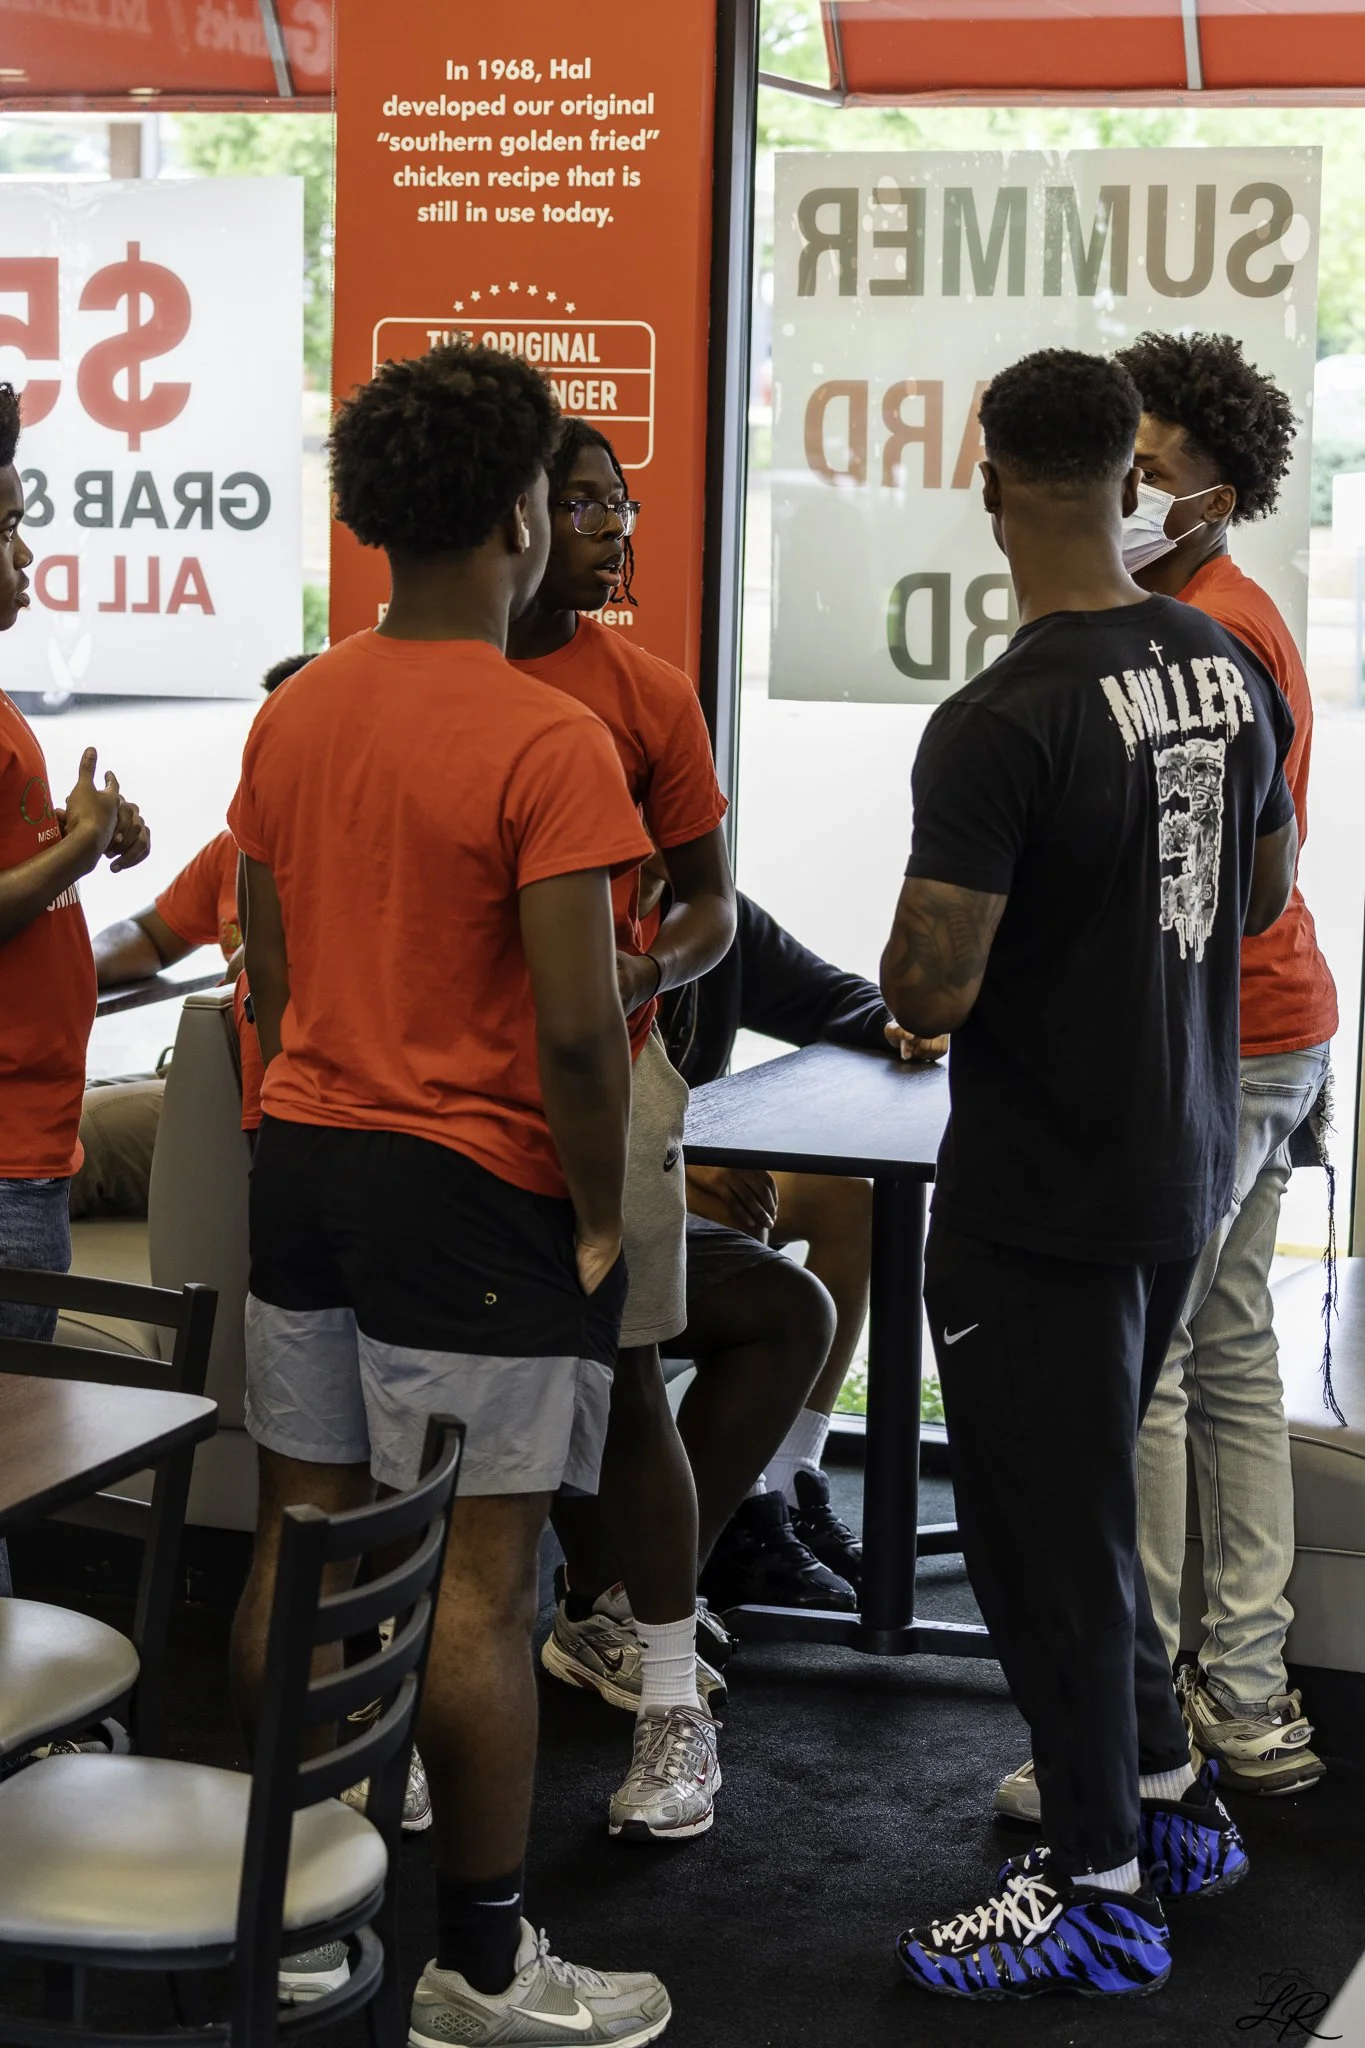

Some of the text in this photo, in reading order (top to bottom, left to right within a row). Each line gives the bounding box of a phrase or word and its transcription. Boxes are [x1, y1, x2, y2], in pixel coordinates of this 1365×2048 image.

[447, 57, 591, 83] In 1968, Hal
[382, 92, 654, 121] developed our original
[376, 128, 660, 157] “southern golden fried”
[393, 165, 641, 192] chicken recipe that is
[417, 200, 614, 228] still in use today.
[482, 331, 600, 363] ORIGINAL
[548, 379, 618, 411] NGER
[1099, 655, 1255, 762] MILLER
